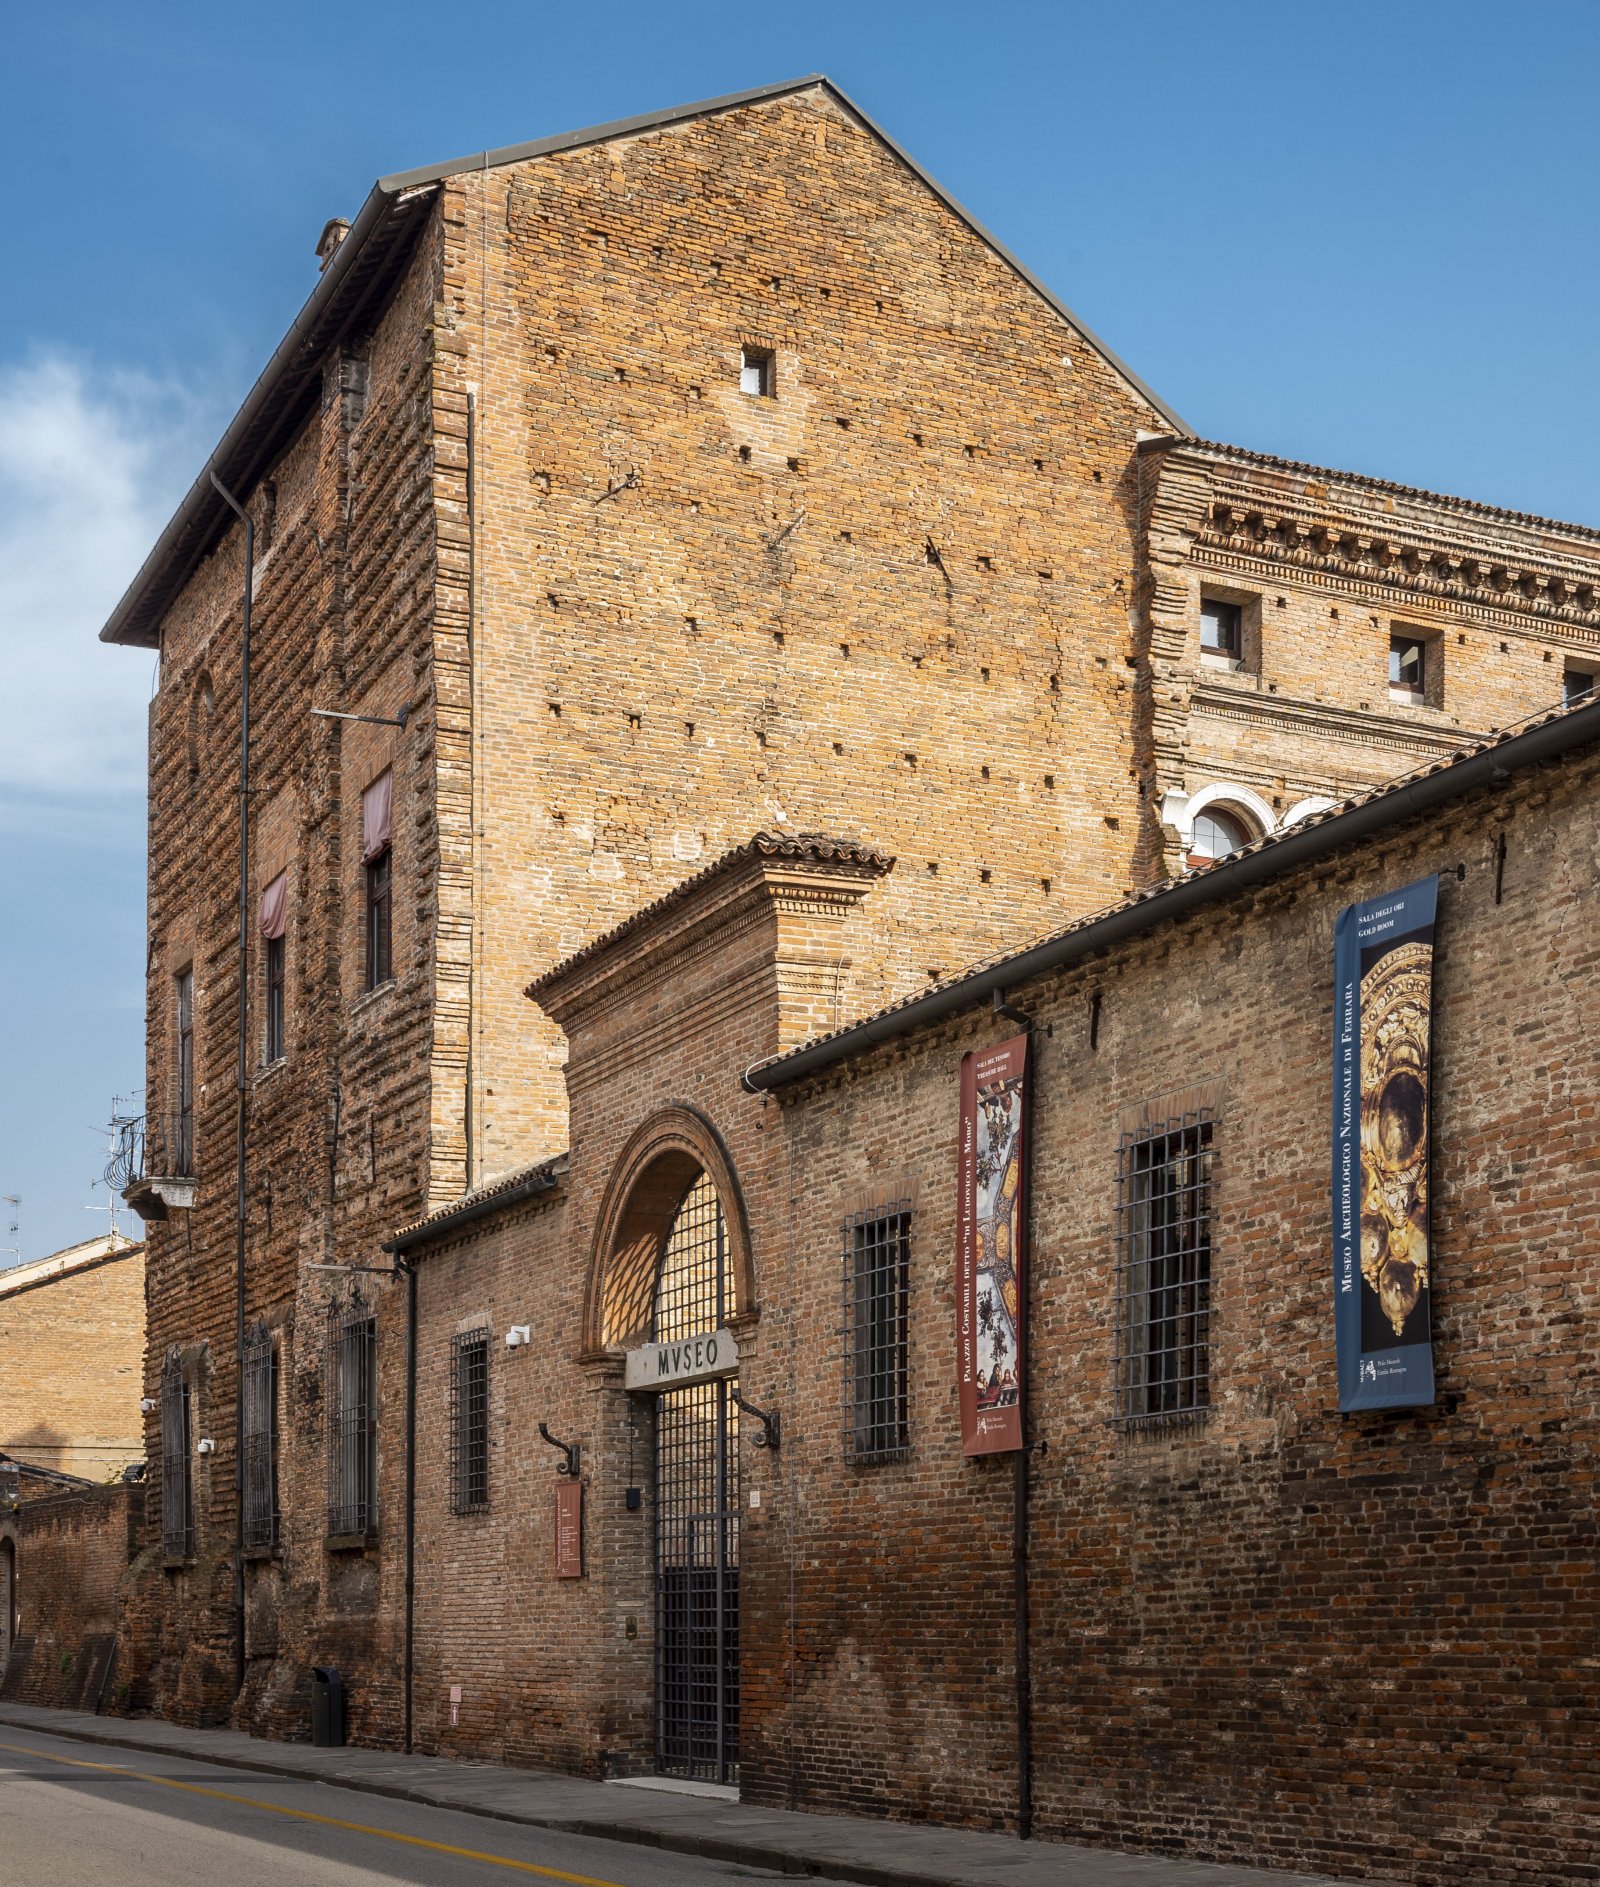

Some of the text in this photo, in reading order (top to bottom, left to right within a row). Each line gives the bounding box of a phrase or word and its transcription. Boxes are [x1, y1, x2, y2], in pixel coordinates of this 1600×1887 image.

[1358, 901, 1405, 925] SALA DEGLI ORI
[1358, 919, 1394, 938] GOLD ROOM
[658, 1338, 718, 1377] MVSEO
